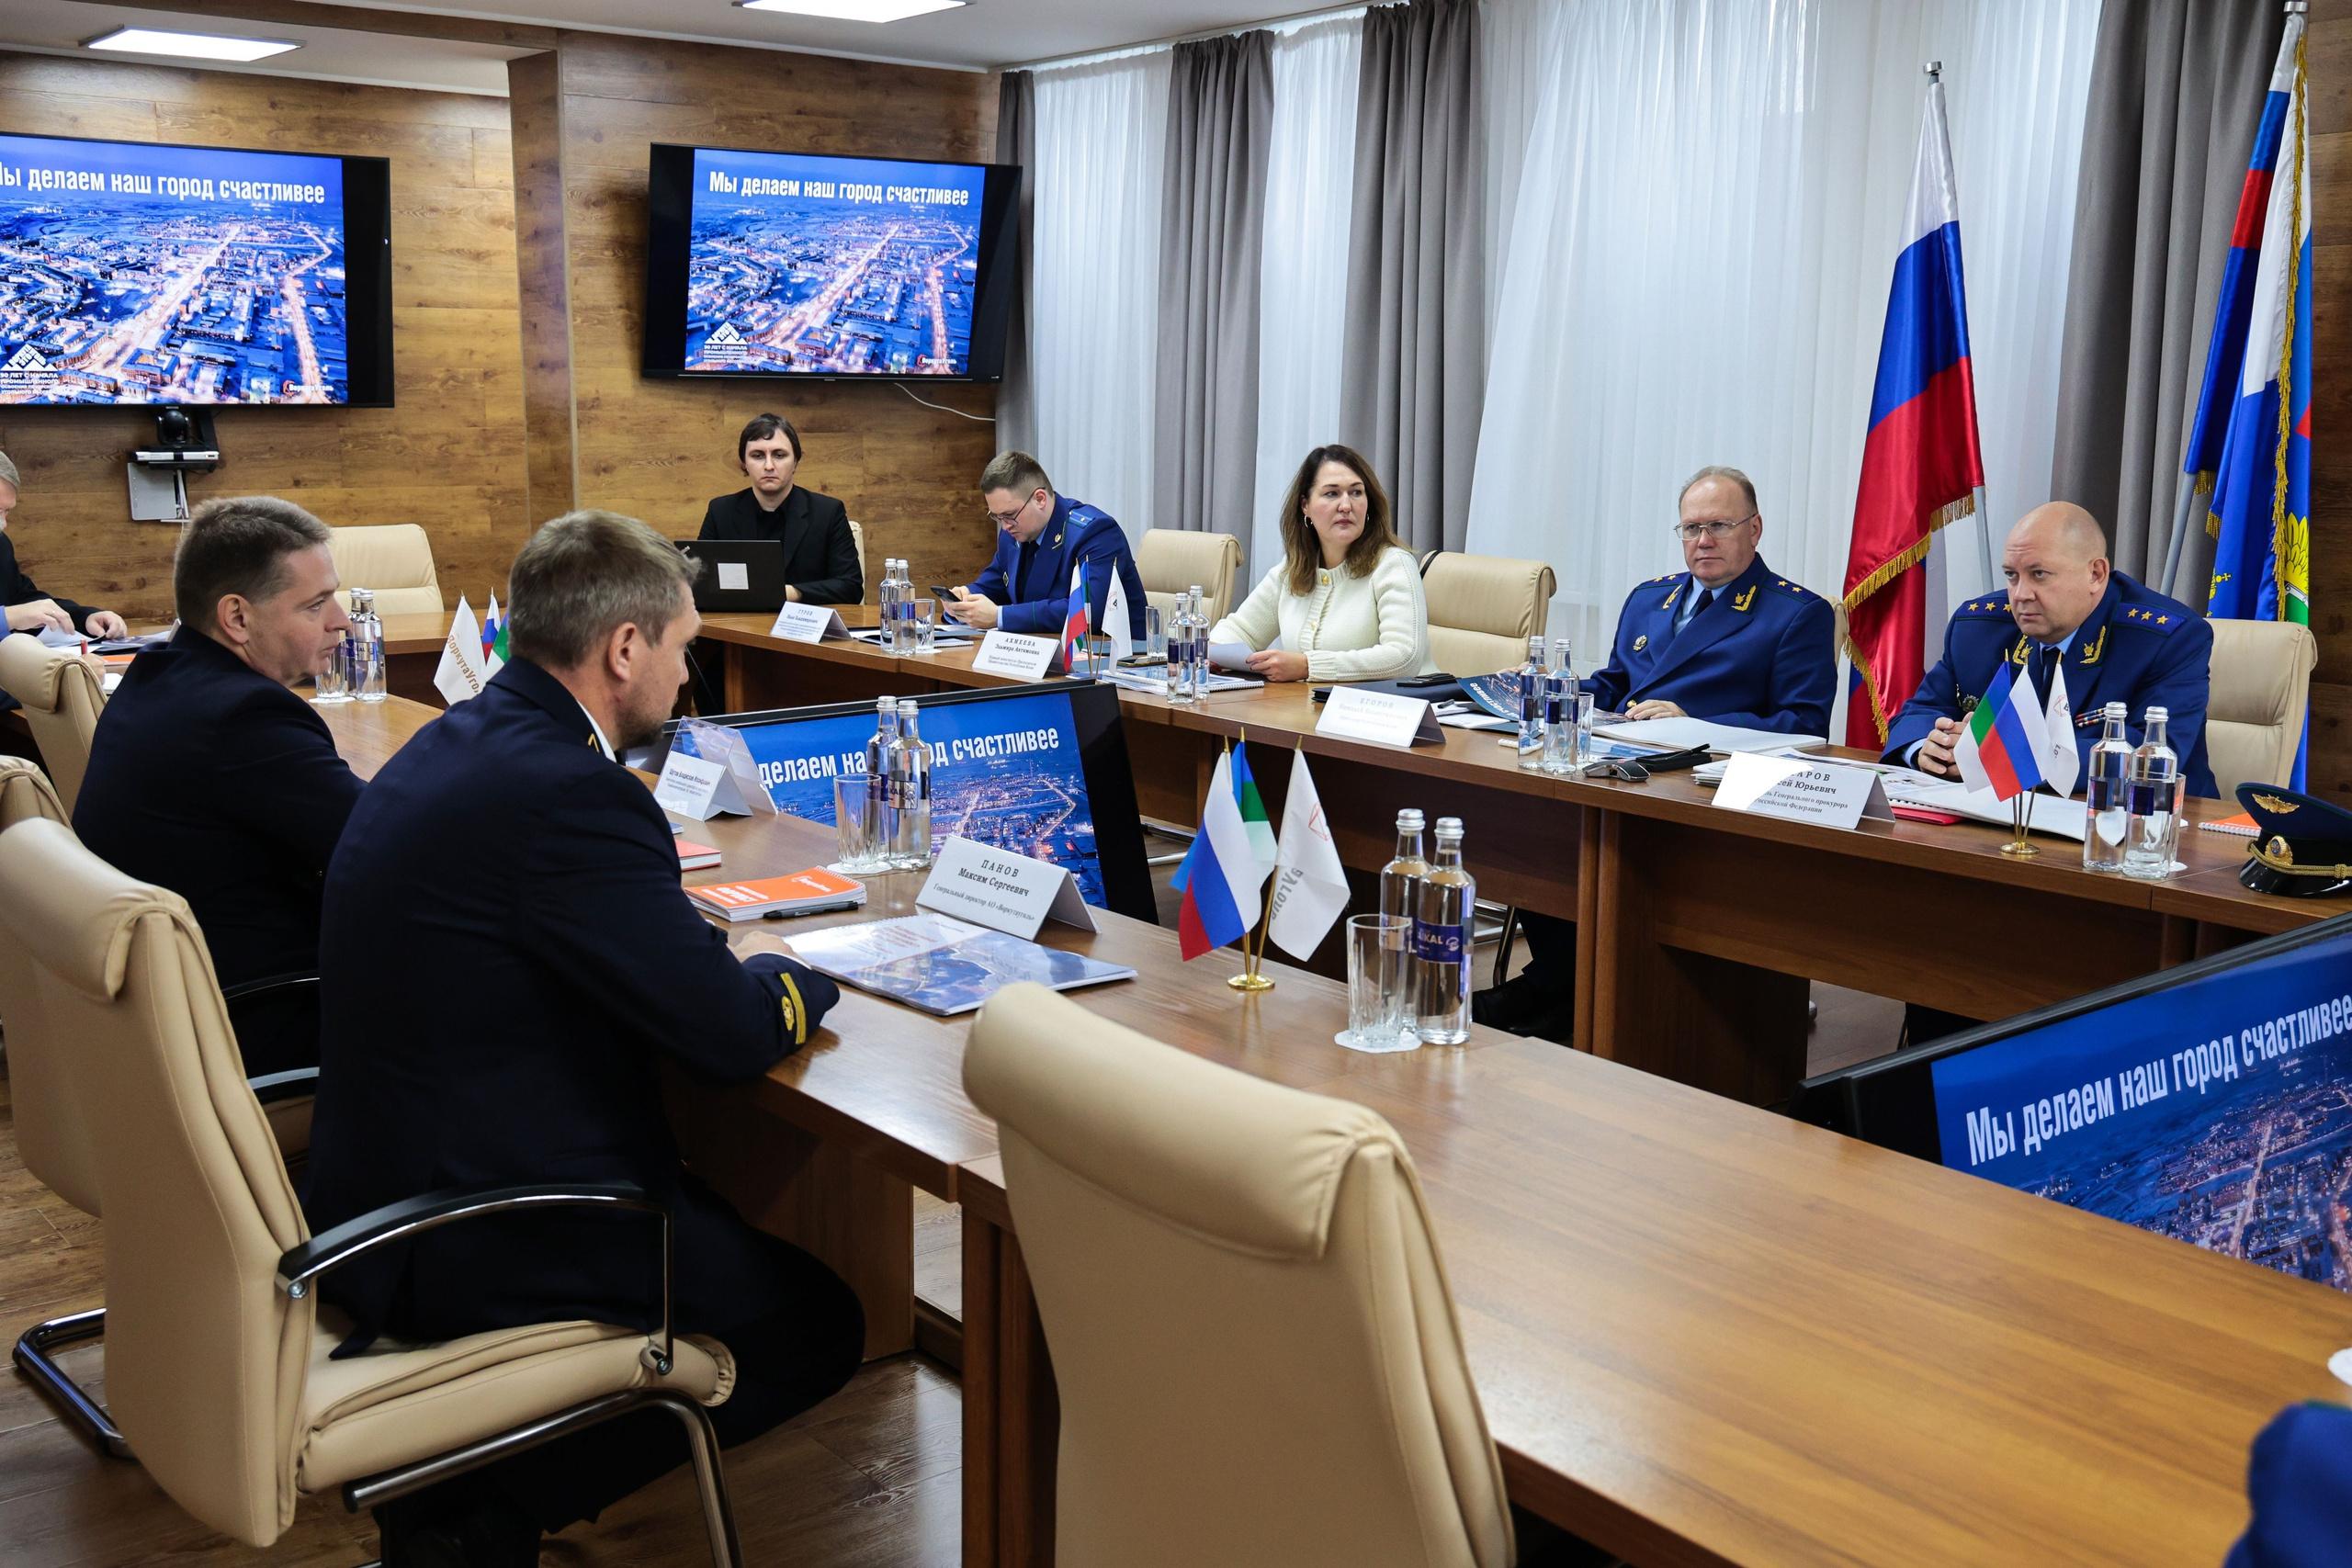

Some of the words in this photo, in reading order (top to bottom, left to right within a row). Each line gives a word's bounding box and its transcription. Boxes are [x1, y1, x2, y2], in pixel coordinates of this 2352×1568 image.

[28, 168, 105, 192] делаем
[111, 174, 151, 193] наш
[158, 176, 215, 200] город
[220, 179, 325, 204] счастливее
[709, 171, 737, 194] Мы
[741, 176, 799, 198] делаем
[804, 180, 835, 199] наш
[839, 183, 882, 205] город
[886, 186, 969, 206] счастливее
[1005, 638, 1035, 647] АХМЕЕВА
[447, 635, 479, 693] ВоркутаУго
[1360, 698, 1394, 708] ЕГОРОВ
[758, 755, 837, 789] делаем
[842, 751, 868, 774] на
[952, 728, 1059, 761] счастливее
[1796, 771, 1830, 781] АРОВ
[1795, 781, 1837, 794] Юрьевич
[1774, 791, 1815, 803] Генерального
[1815, 799, 1848, 809] прокурора
[1789, 803, 1822, 813] Федерации
[981, 859, 1019, 878] ПАНОВ
[958, 868, 987, 885] Максим
[989, 877, 1029, 897] Сергеевич
[933, 883, 964, 899] Генеральный
[965, 892, 986, 907] директор
[987, 900, 995, 908] АО
[1966, 1106, 2016, 1166] Мы
[2022, 1077, 2115, 1156] делаем
[2120, 1057, 2168, 1111] наш
[2173, 1033, 2238, 1095] город
[2241, 995, 2352, 1066] счастливее
